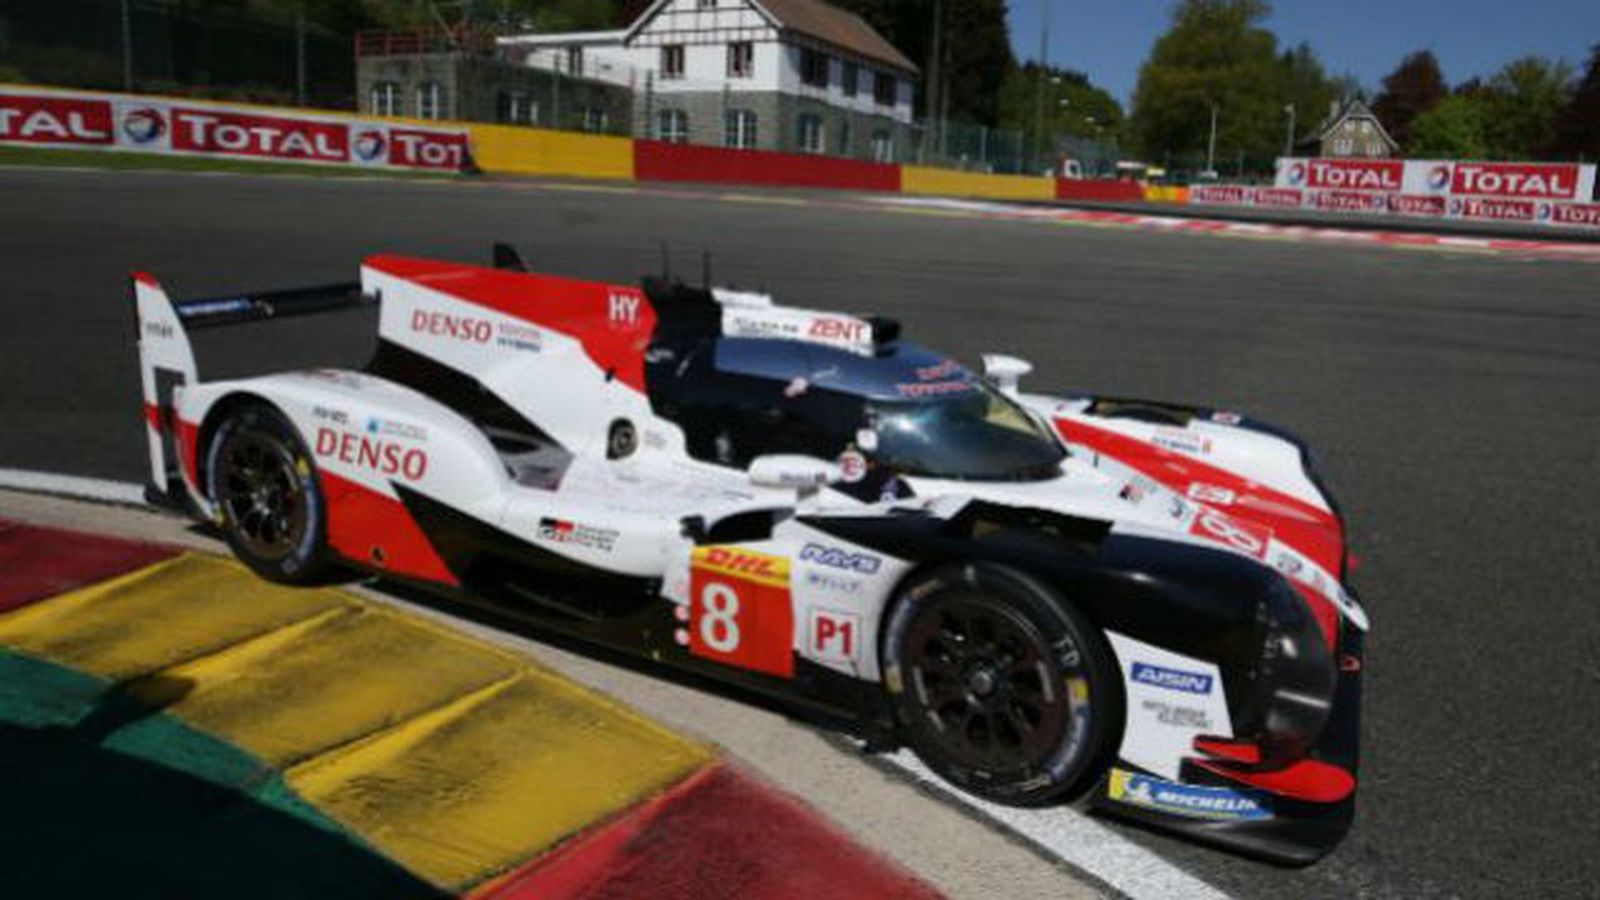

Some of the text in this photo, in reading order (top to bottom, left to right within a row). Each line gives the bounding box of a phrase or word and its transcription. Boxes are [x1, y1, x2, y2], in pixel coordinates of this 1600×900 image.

[178, 114, 345, 158] TOTAL
[1313, 159, 1399, 188] TOTAL
[1457, 166, 1571, 194] TOTAL
[608, 293, 640, 323] HY
[411, 308, 493, 343] DENSO
[807, 317, 865, 340] ZENT
[315, 426, 428, 481] DENSO
[705, 548, 777, 577] DHL
[799, 542, 882, 574] RAYS
[700, 582, 740, 653] 8
[815, 615, 853, 656] P1
[1138, 666, 1208, 691] AISIN
